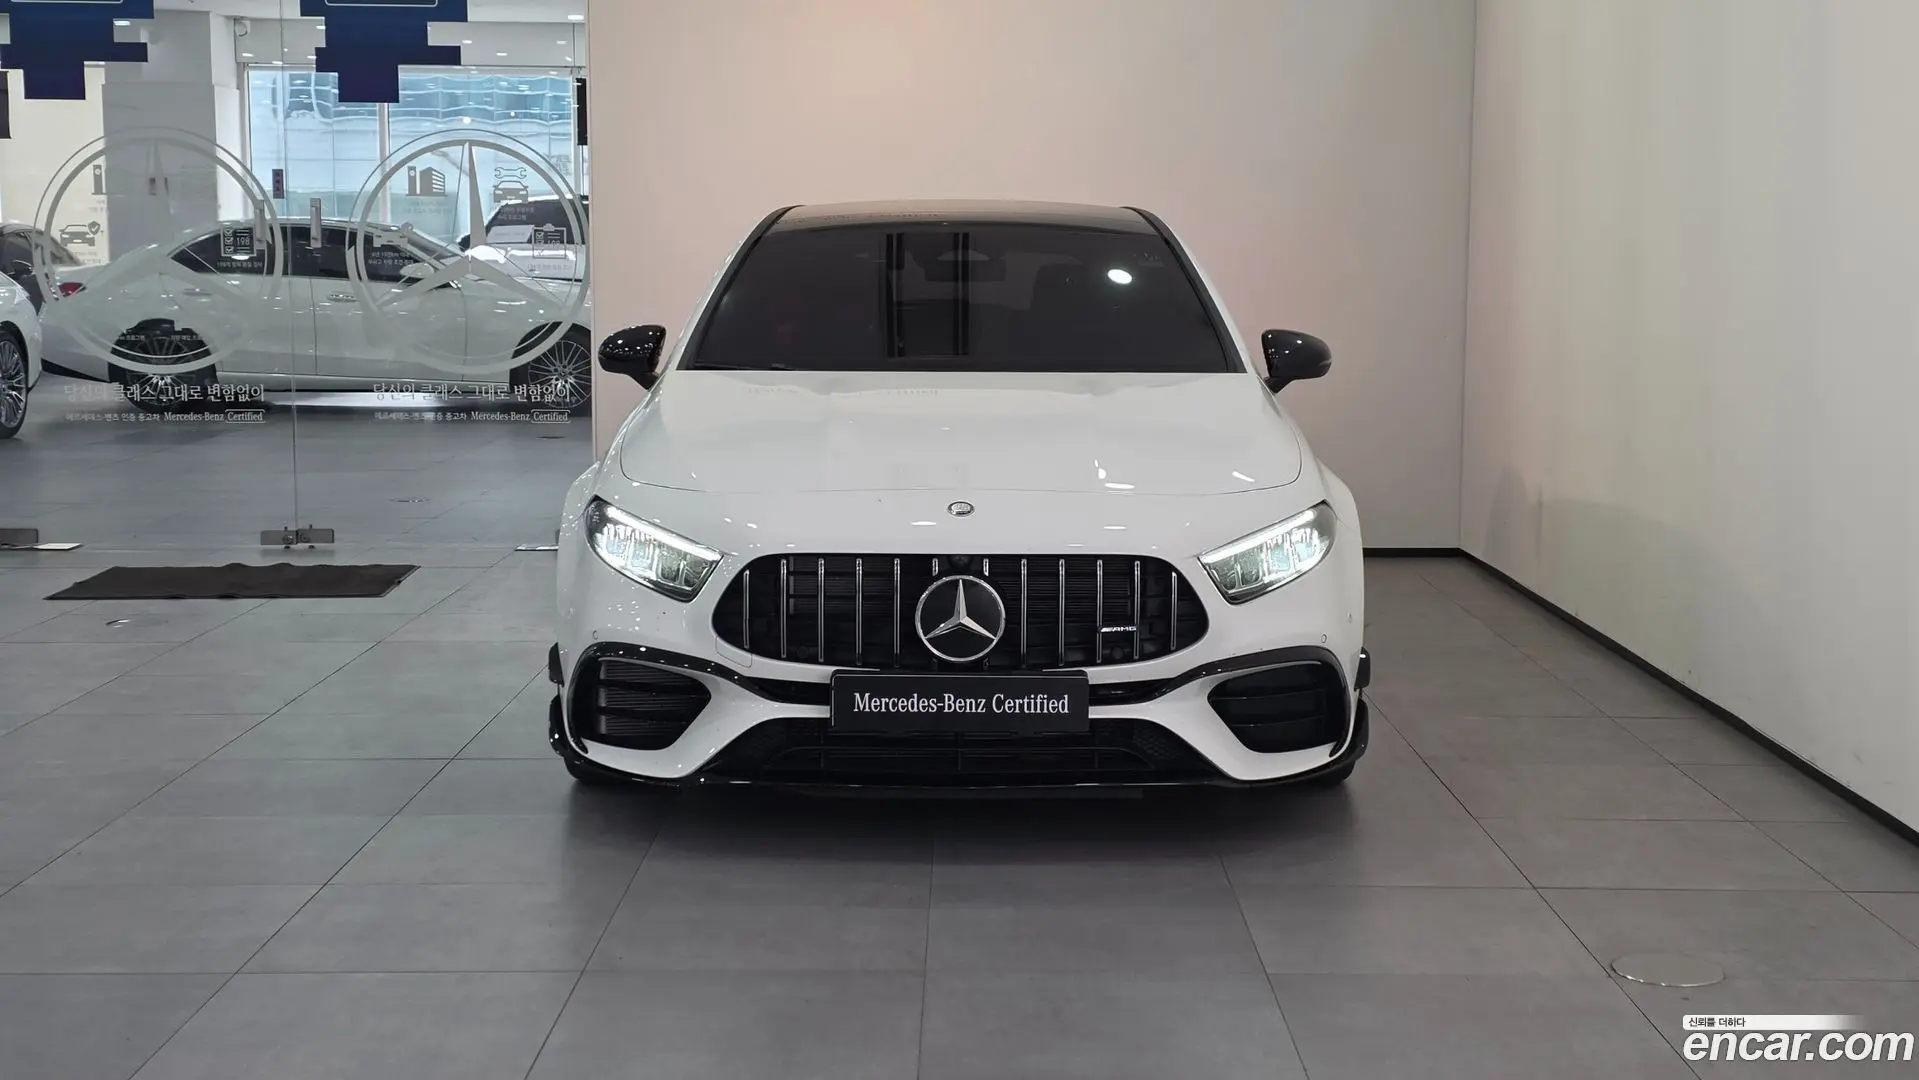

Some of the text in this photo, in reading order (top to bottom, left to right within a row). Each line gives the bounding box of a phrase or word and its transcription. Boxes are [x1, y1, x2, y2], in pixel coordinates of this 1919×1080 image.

[64, 384, 265, 403] 당신의 클래스 그대로 변함없이
[373, 383, 570, 403] 당신의 클래스 그대로 변함없이
[164, 411, 224, 421] Mercedes-Benz
[227, 410, 263, 421] Certified
[470, 411, 530, 421] Mercedes-Benz
[533, 411, 569, 421] Certified
[853, 692, 1069, 714] Mercedes-Benz Certified
